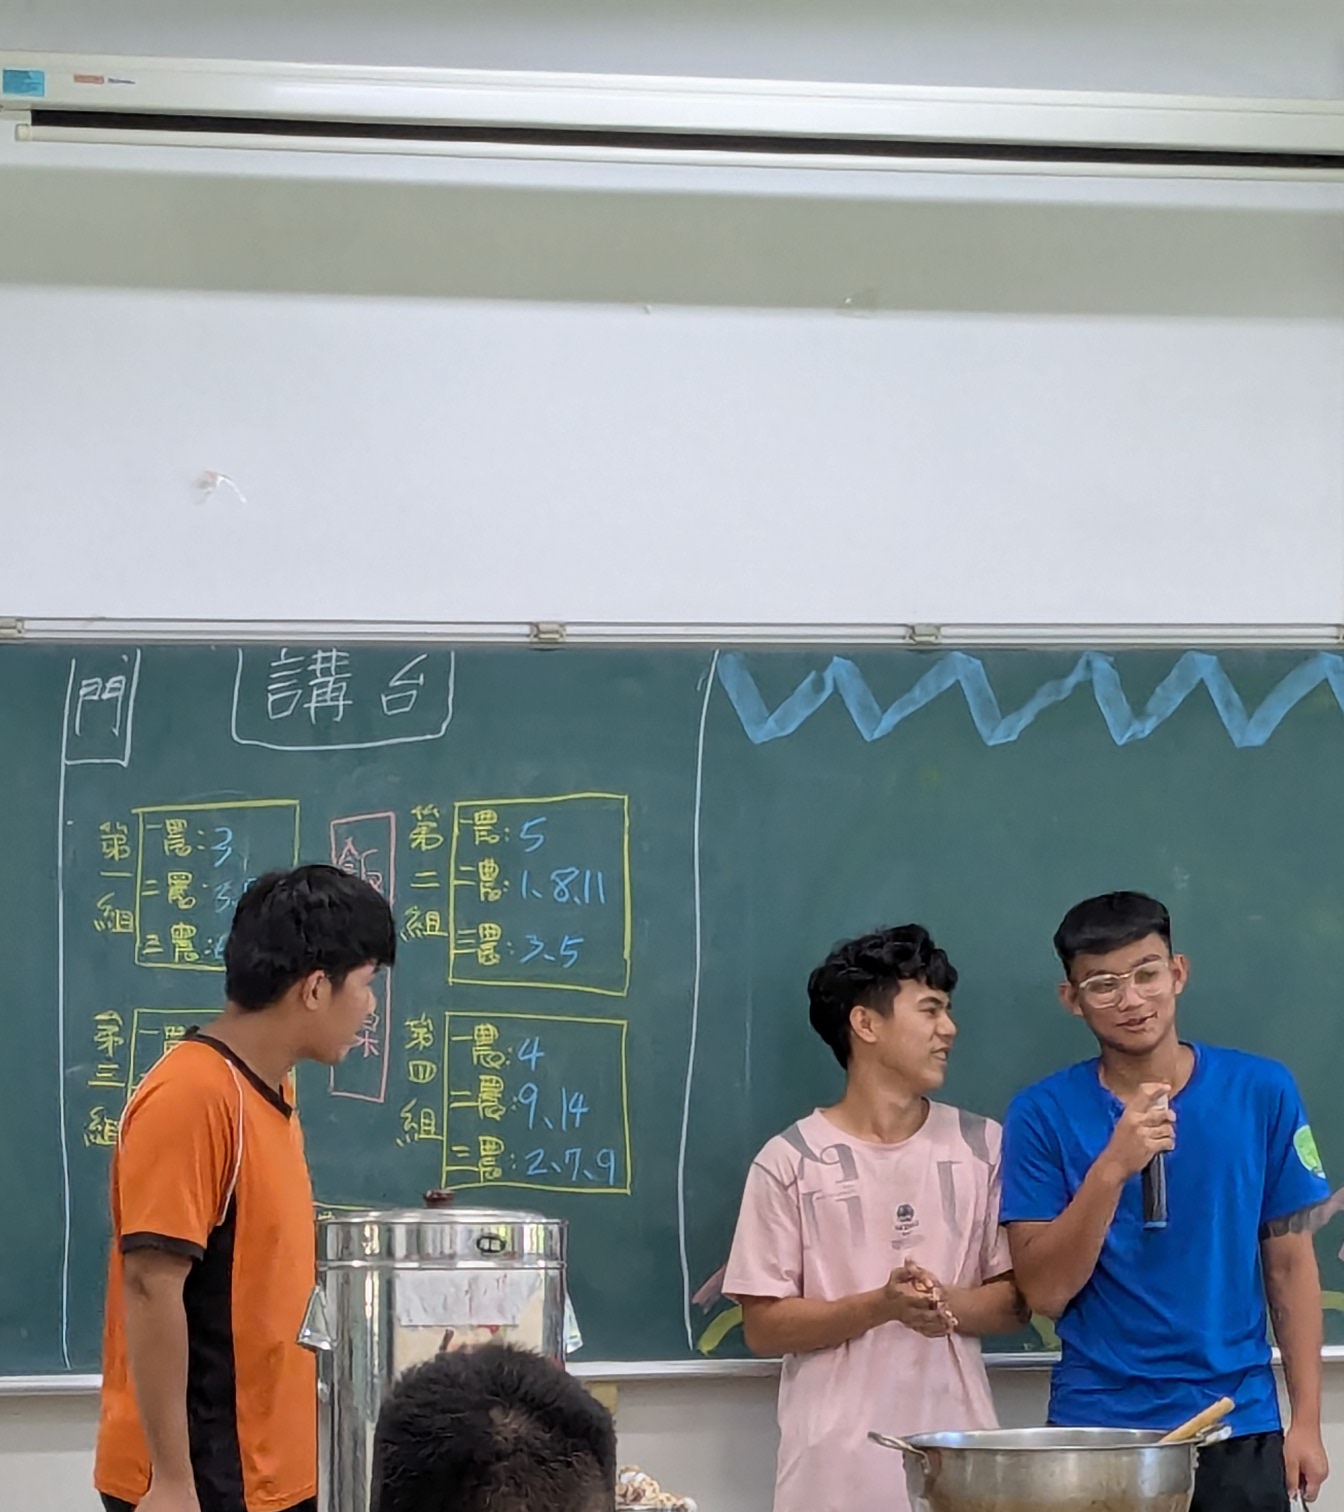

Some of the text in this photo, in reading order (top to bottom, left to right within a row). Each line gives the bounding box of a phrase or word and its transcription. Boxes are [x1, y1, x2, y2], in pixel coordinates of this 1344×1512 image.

[74, 674, 127, 737] 門
[266, 647, 429, 725] 講台
[93, 821, 135, 933] 第一組
[400, 803, 449, 942] 第二組
[396, 1012, 445, 1148] 第四組
